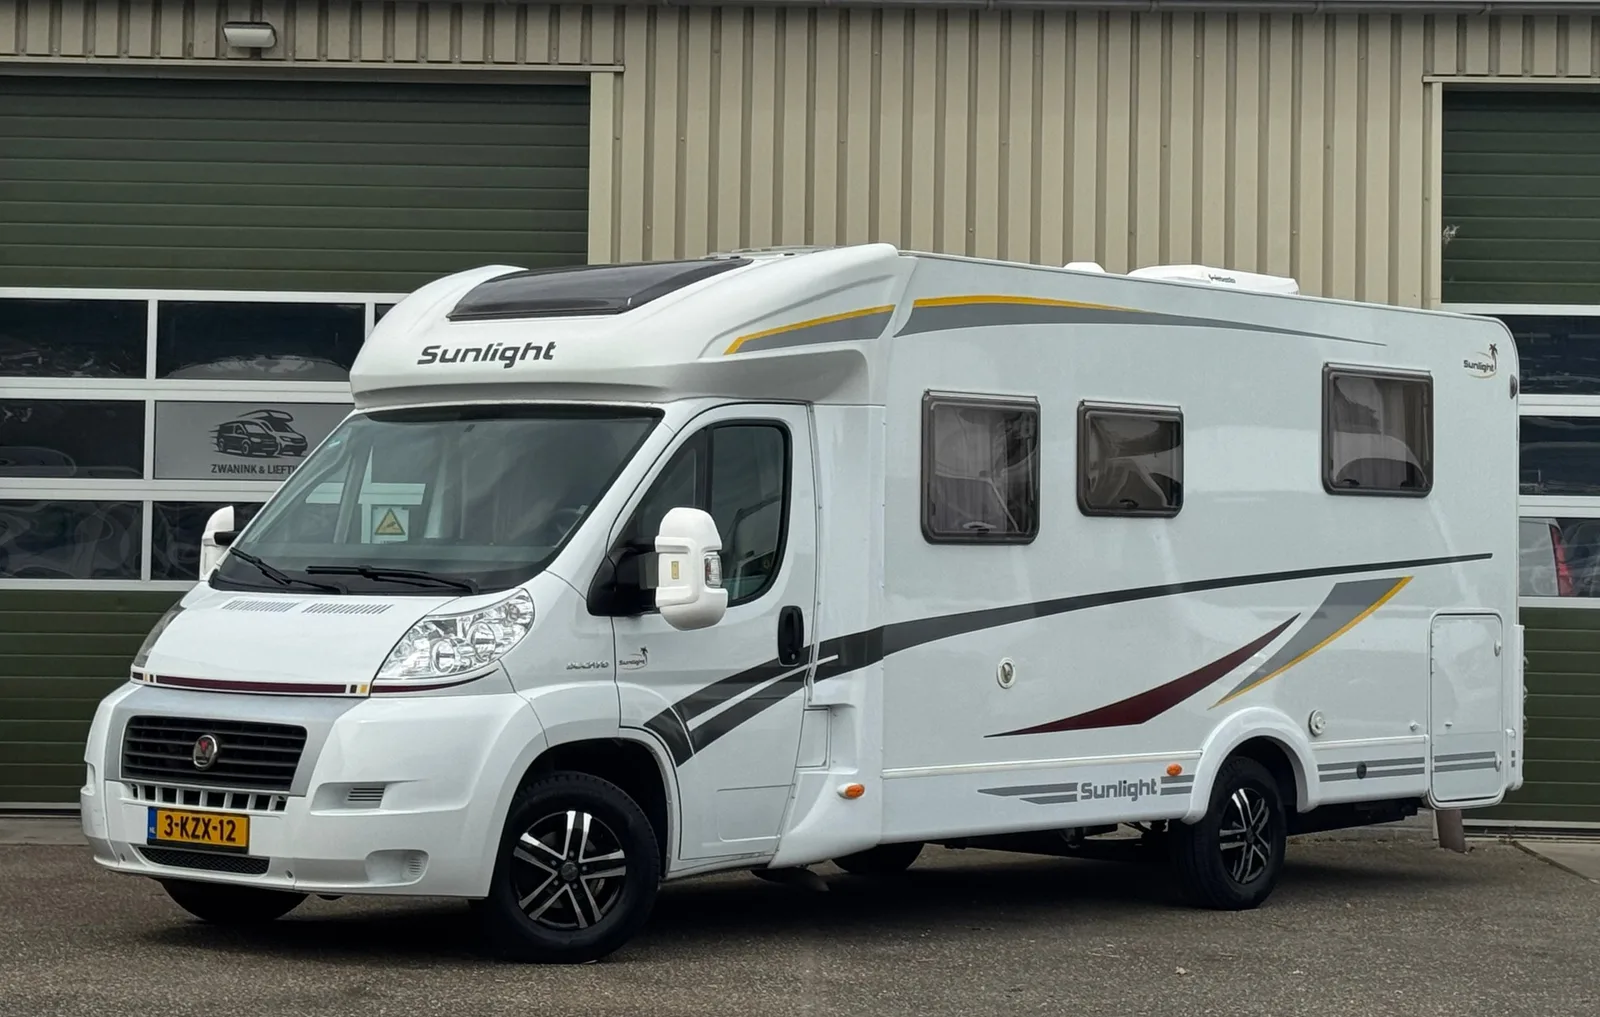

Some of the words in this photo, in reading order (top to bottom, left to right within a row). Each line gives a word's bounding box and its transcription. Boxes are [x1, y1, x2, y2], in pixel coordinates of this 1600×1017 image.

[417, 341, 556, 369] Sunlight
[1463, 359, 1494, 373] Sunlight
[211, 464, 257, 474] ZWANINK
[259, 465, 265, 474] &
[267, 464, 298, 474] LIEFTI
[1080, 778, 1157, 802] Sunlight
[164, 814, 236, 842] 3-KZX-12
